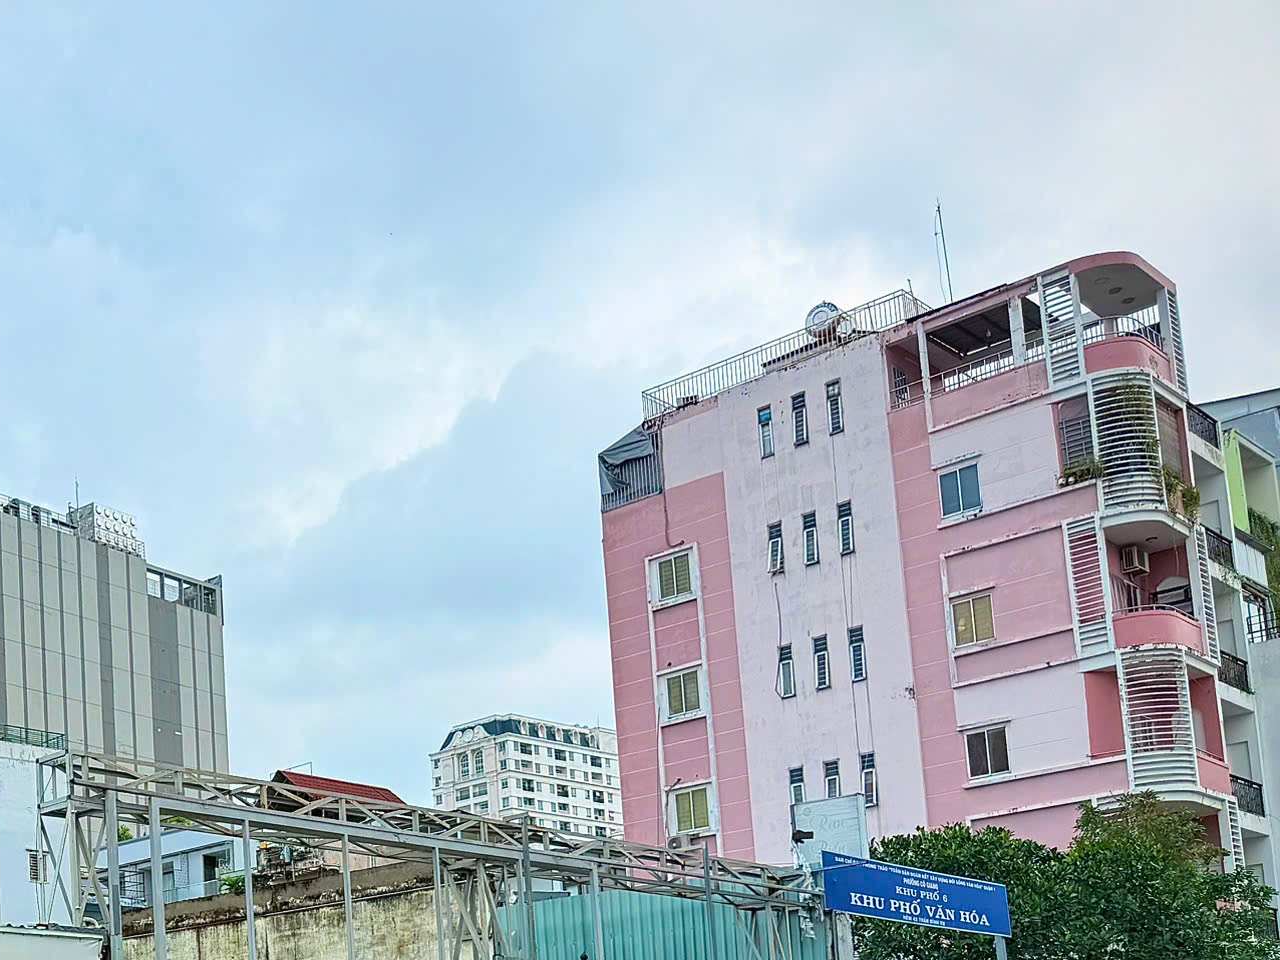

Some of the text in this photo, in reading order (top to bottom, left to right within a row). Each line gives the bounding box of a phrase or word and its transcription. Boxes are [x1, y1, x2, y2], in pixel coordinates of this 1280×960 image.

[895, 886, 948, 903] KHU PHỐ 6
[849, 892, 990, 926] KHU PHỐ VĂN HÓA
